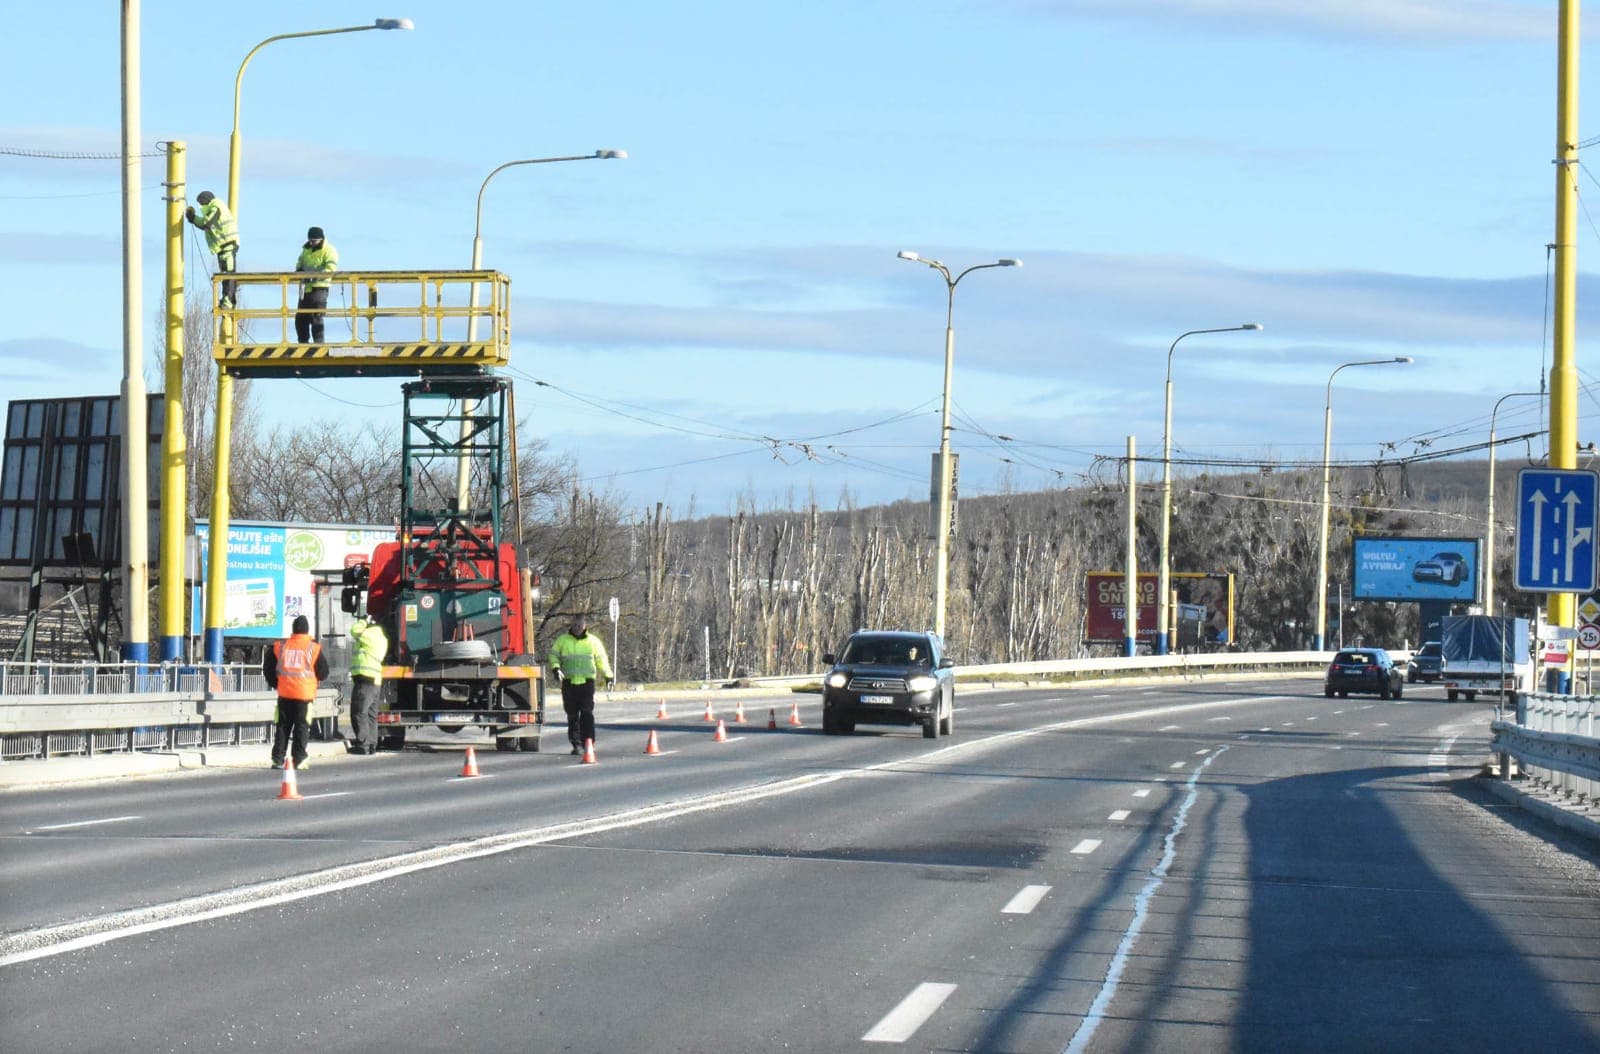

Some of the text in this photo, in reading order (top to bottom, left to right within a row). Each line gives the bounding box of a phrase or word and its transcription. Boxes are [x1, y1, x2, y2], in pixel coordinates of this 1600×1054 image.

[198, 529, 263, 542] NPUJTE
[1098, 581, 1155, 593] CASNO
[1098, 592, 1155, 604] ONNE
